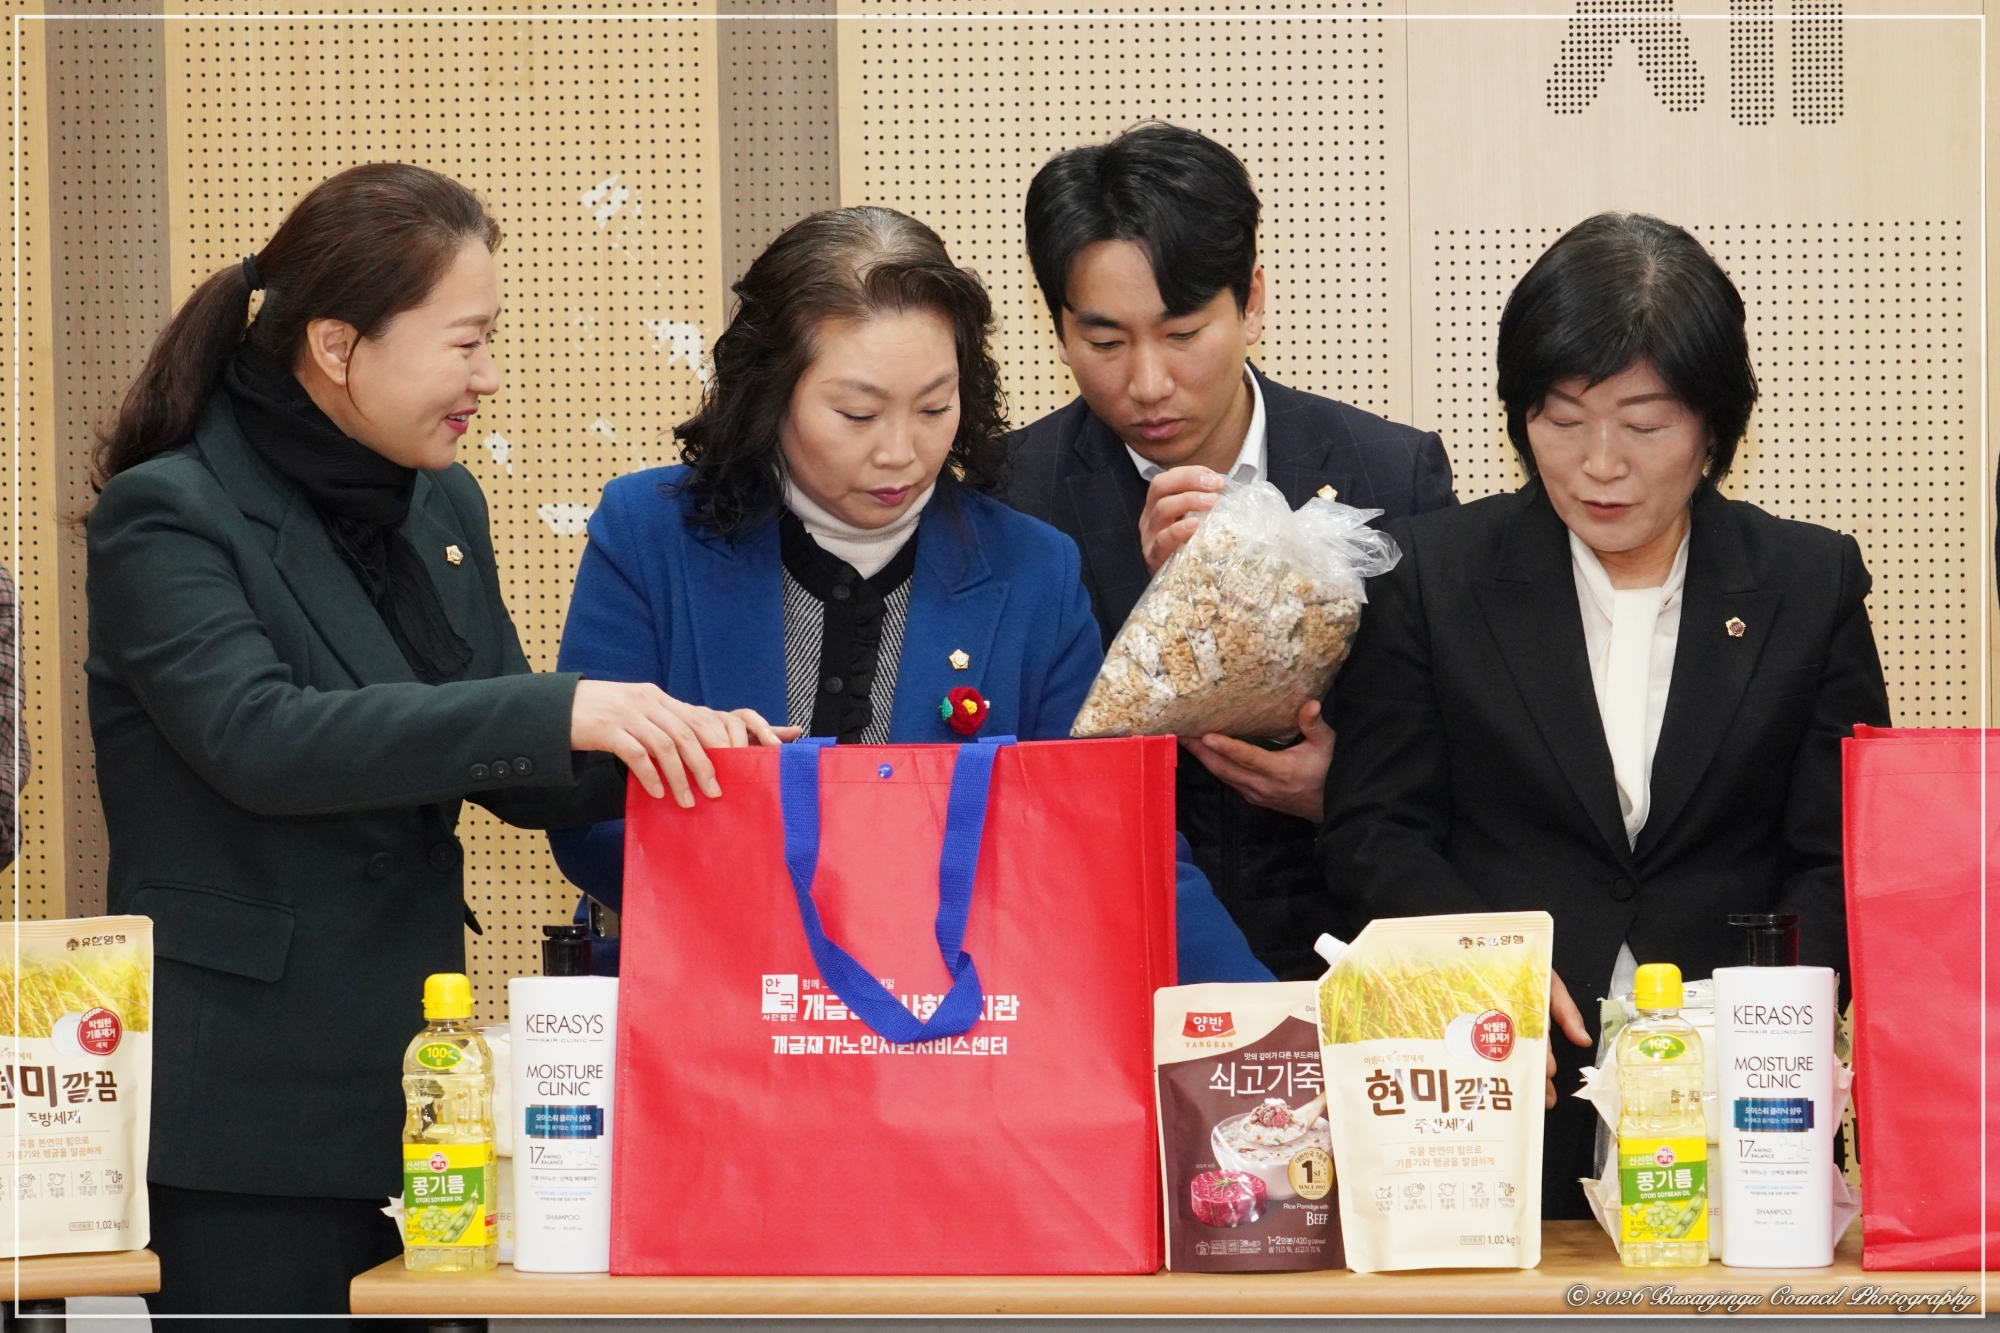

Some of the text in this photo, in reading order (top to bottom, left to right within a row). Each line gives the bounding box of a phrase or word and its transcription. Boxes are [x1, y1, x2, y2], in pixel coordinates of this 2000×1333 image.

[802, 979, 819, 990] 함께
[762, 1013, 797, 1021] 사단법인
[1734, 1005, 1813, 1025] KERASYS
[526, 1014, 604, 1034] KERASYS
[1193, 1016, 1224, 1032] 양반
[1185, 1041, 1234, 1049] YANGBAN
[1244, 1052, 1258, 1060] 맛의
[1259, 1051, 1277, 1060] 깊이가
[1279, 1051, 1292, 1059] 다른
[1735, 1056, 1813, 1071] MOISTURE
[526, 1064, 603, 1079] MOISTURE
[1209, 1062, 1324, 1097] 쇠고기죽
[1747, 1073, 1801, 1088] CLINIC
[62, 1071, 118, 1104] 깔끔
[538, 1081, 590, 1096] CLINIC
[1366, 1068, 1513, 1116] 현미 깔끔
[530, 1146, 545, 1164] 17
[1739, 1140, 1755, 1158] 17
[407, 1161, 428, 1170] 신선한
[1629, 1155, 1653, 1166] 신선한
[412, 1175, 465, 1196] 콩기름
[1636, 1169, 1693, 1191] 콩기름
[1296, 1203, 1319, 1211] Porridge
[96, 1220, 112, 1230] 1.02
[1306, 1211, 1328, 1225] BEEF
[1487, 1235, 1505, 1245] 1.02
